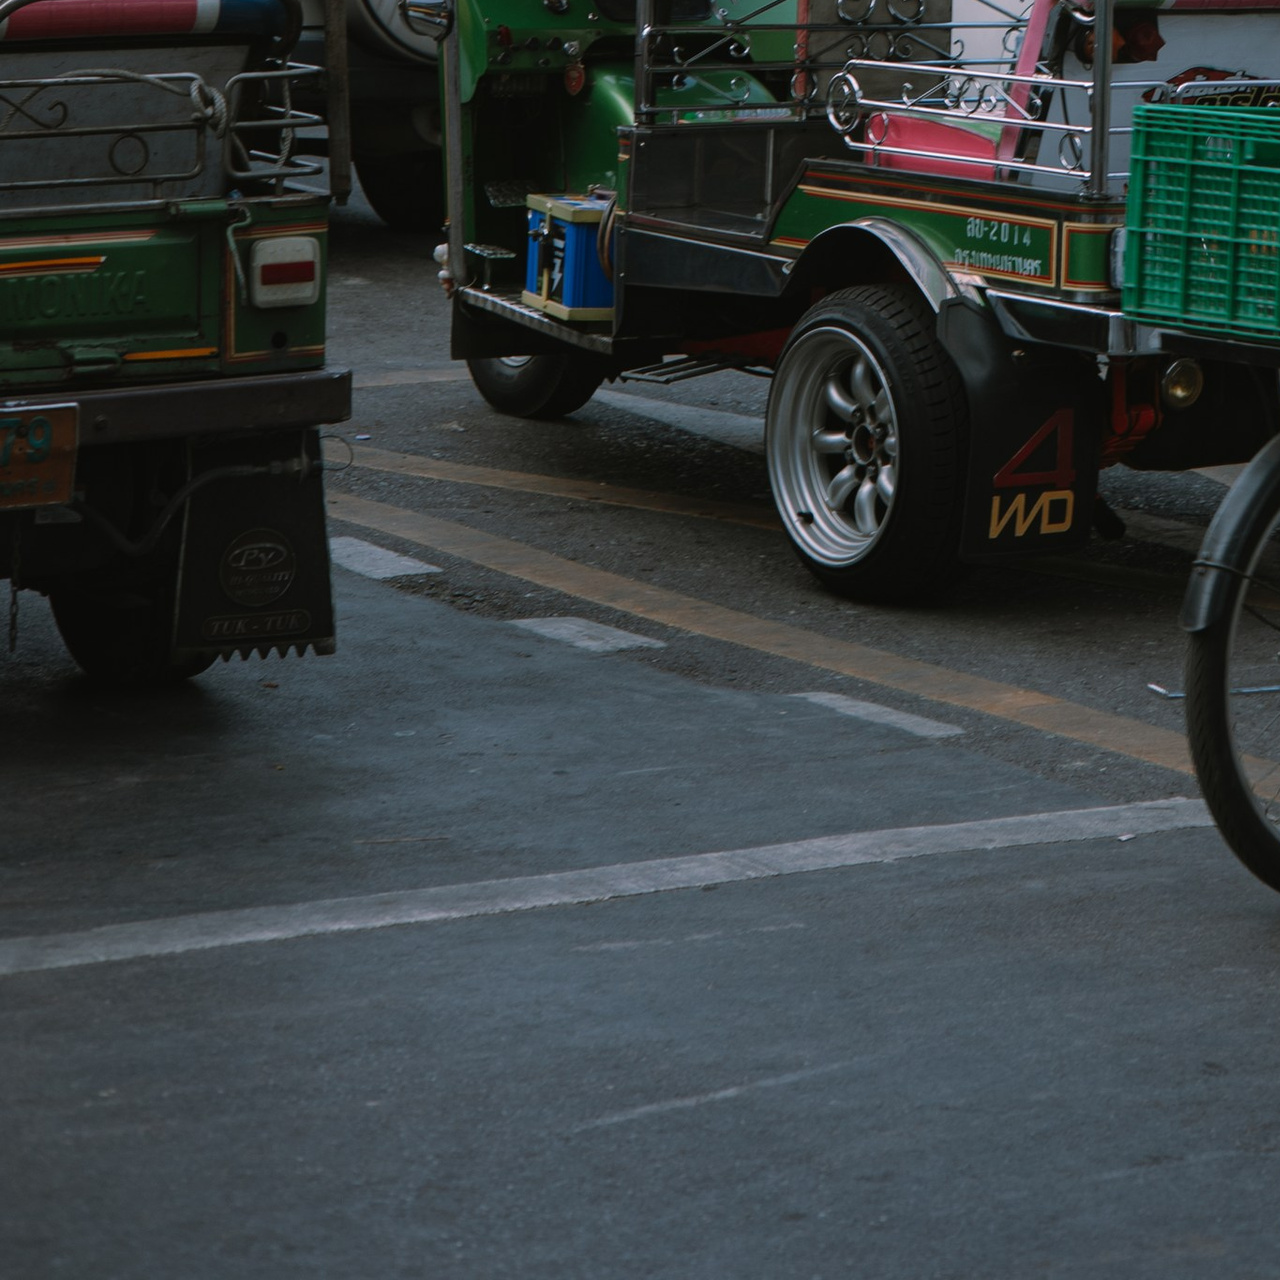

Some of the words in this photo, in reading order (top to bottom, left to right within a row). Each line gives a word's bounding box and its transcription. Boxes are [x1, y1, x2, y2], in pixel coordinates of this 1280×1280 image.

[993, 407, 1075, 489] 4
[989, 489, 1075, 539] WD
[211, 618, 249, 636] TUK
